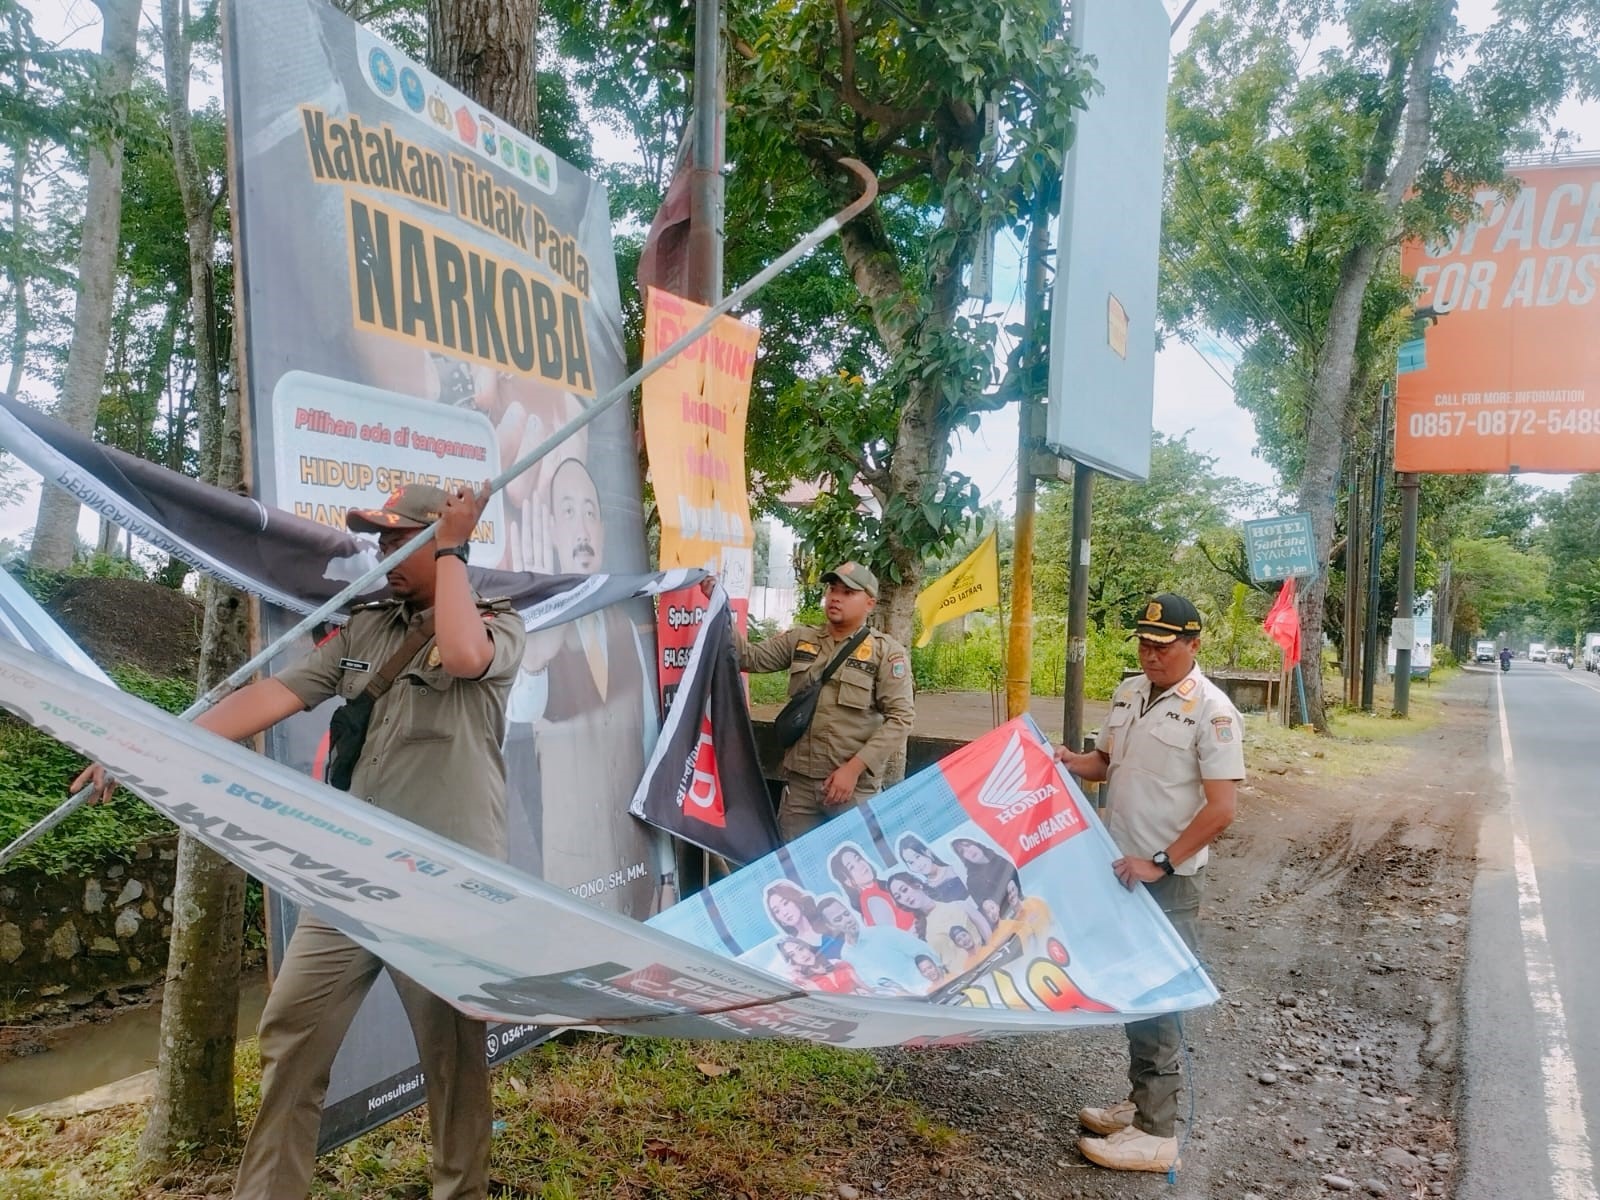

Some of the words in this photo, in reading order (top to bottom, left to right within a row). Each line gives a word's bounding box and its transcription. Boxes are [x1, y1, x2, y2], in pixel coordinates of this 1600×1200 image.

[302, 107, 448, 208] Katakan
[451, 156, 529, 252] Tidak
[531, 204, 591, 298] Pada
[1423, 180, 1600, 261] PACE
[350, 198, 593, 391] NARKOBA
[1413, 260, 1498, 314] FOR
[1502, 254, 1600, 309] ADS
[1435, 394, 1459, 407] CALL
[1462, 393, 1481, 405] FOR
[1483, 391, 1512, 404] MORE
[1515, 389, 1585, 403] INFORMATION
[295, 408, 357, 437] Pilihan
[360, 423, 392, 444] ada
[394, 427, 410, 447] di
[300, 455, 373, 490] HIDUP
[1251, 522, 1305, 538] HOTEL
[1165, 711, 1181, 722] POL
[1183, 716, 1196, 727] PP
[994, 784, 1061, 825] HONDA
[1018, 829, 1041, 852] One
[1037, 808, 1079, 841] HEART.
[568, 878, 608, 899] YONO,
[609, 870, 627, 890] SH,
[627, 862, 648, 882] MM.
[368, 1075, 419, 1111] Konsultasi
